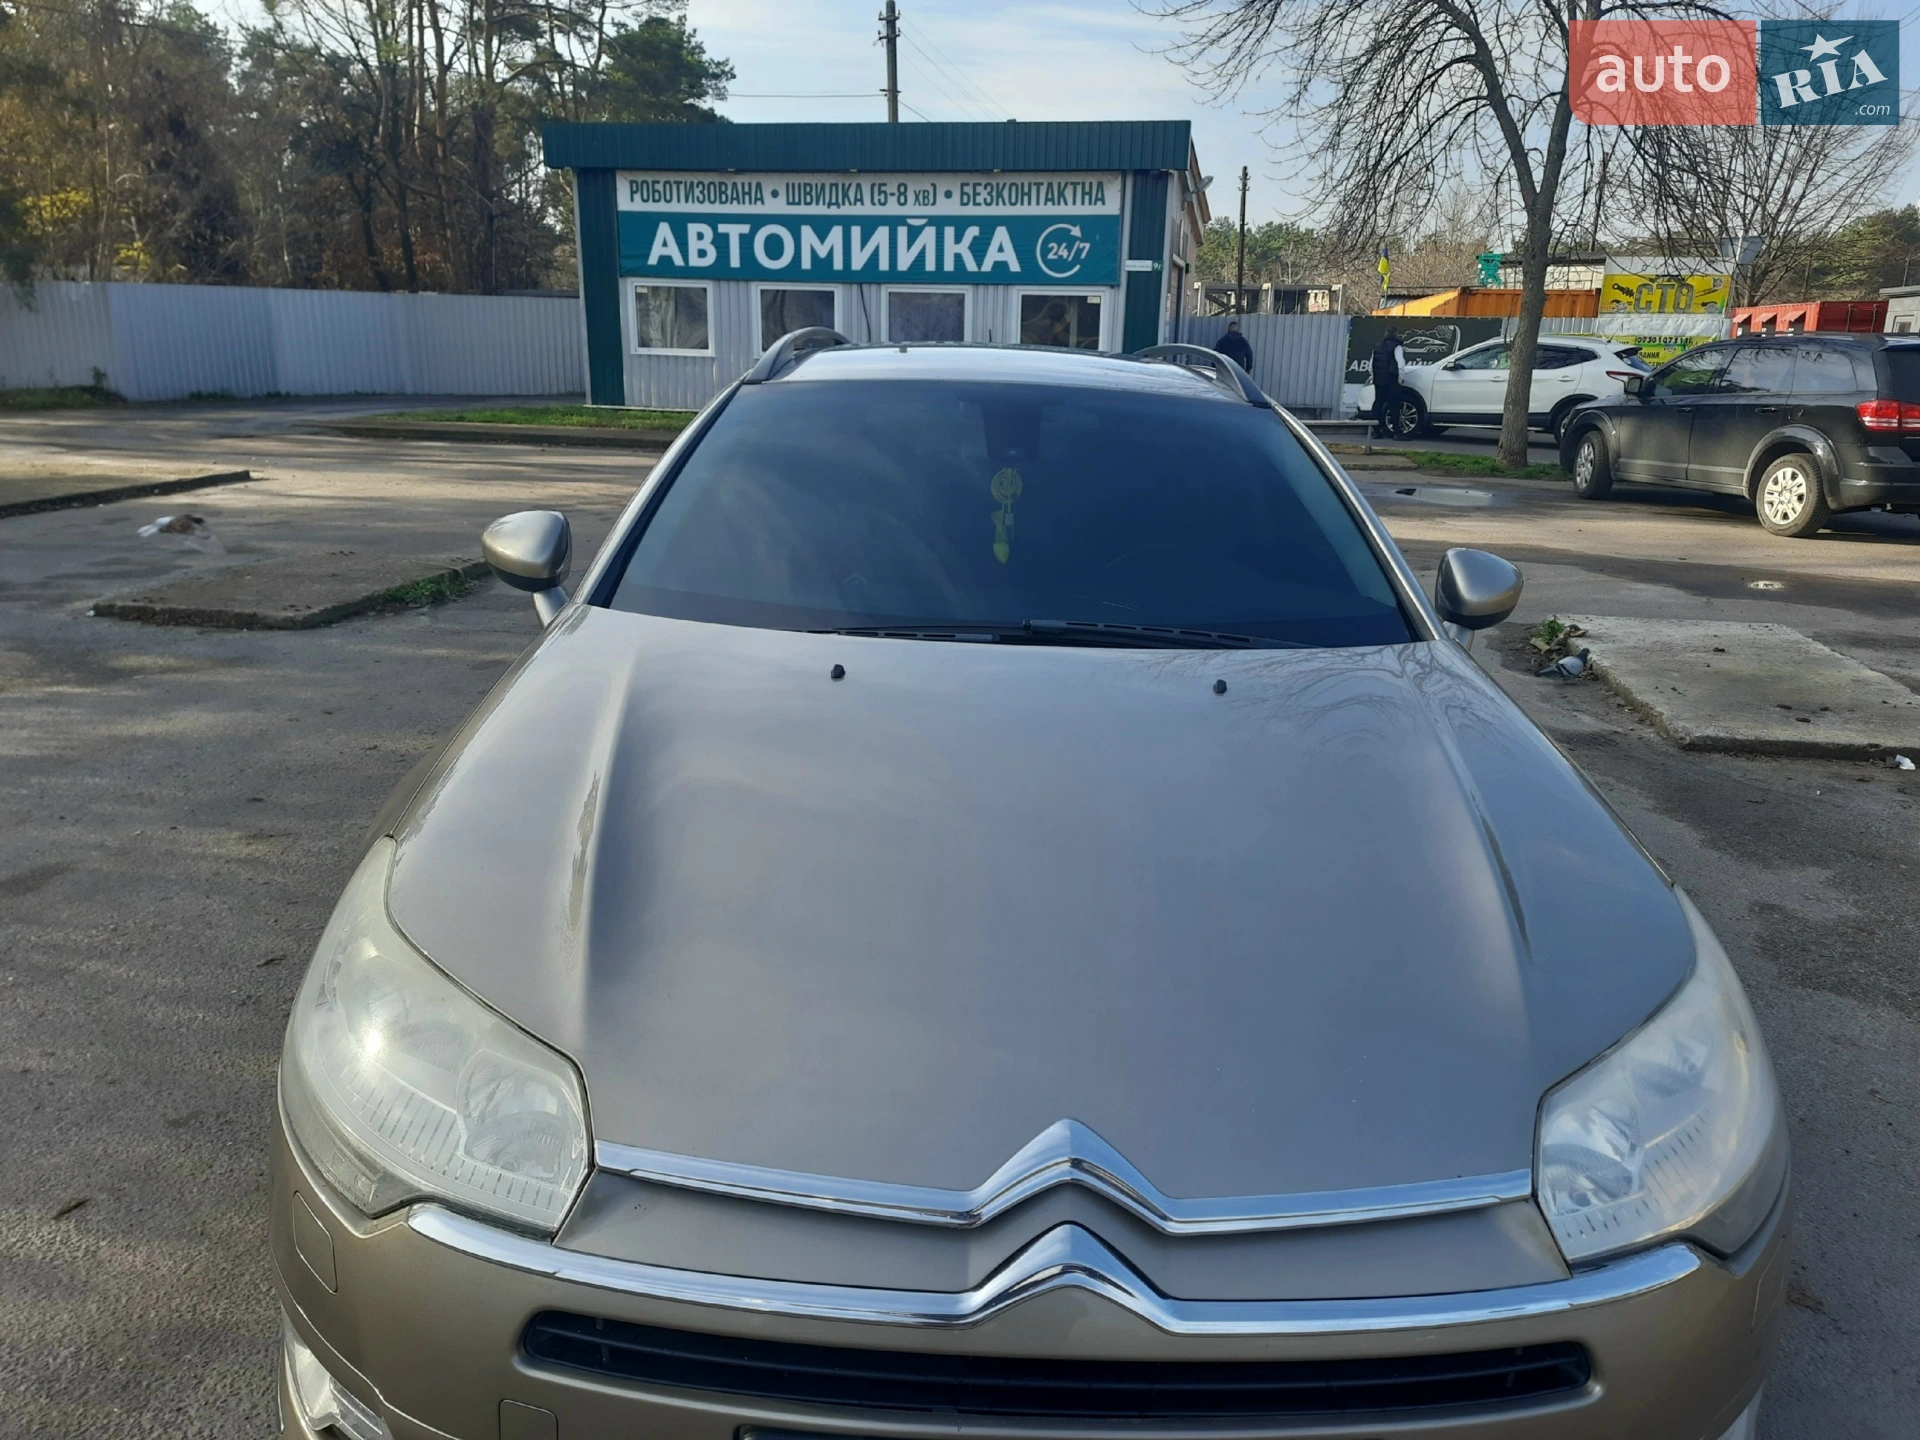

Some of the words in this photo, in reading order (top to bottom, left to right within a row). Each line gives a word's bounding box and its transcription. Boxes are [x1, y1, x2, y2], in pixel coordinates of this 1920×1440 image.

[629, 179, 765, 206] РОБОТИЗОВАНА
[785, 182, 864, 209] ШВИДКА
[870, 182, 908, 206] (5-8
[959, 182, 1106, 206] БЕЗКОНТАКТНА
[647, 218, 1022, 272] АВТОМИЙКА
[1047, 241, 1091, 262] 24/7
[1634, 283, 1694, 314] СТО
